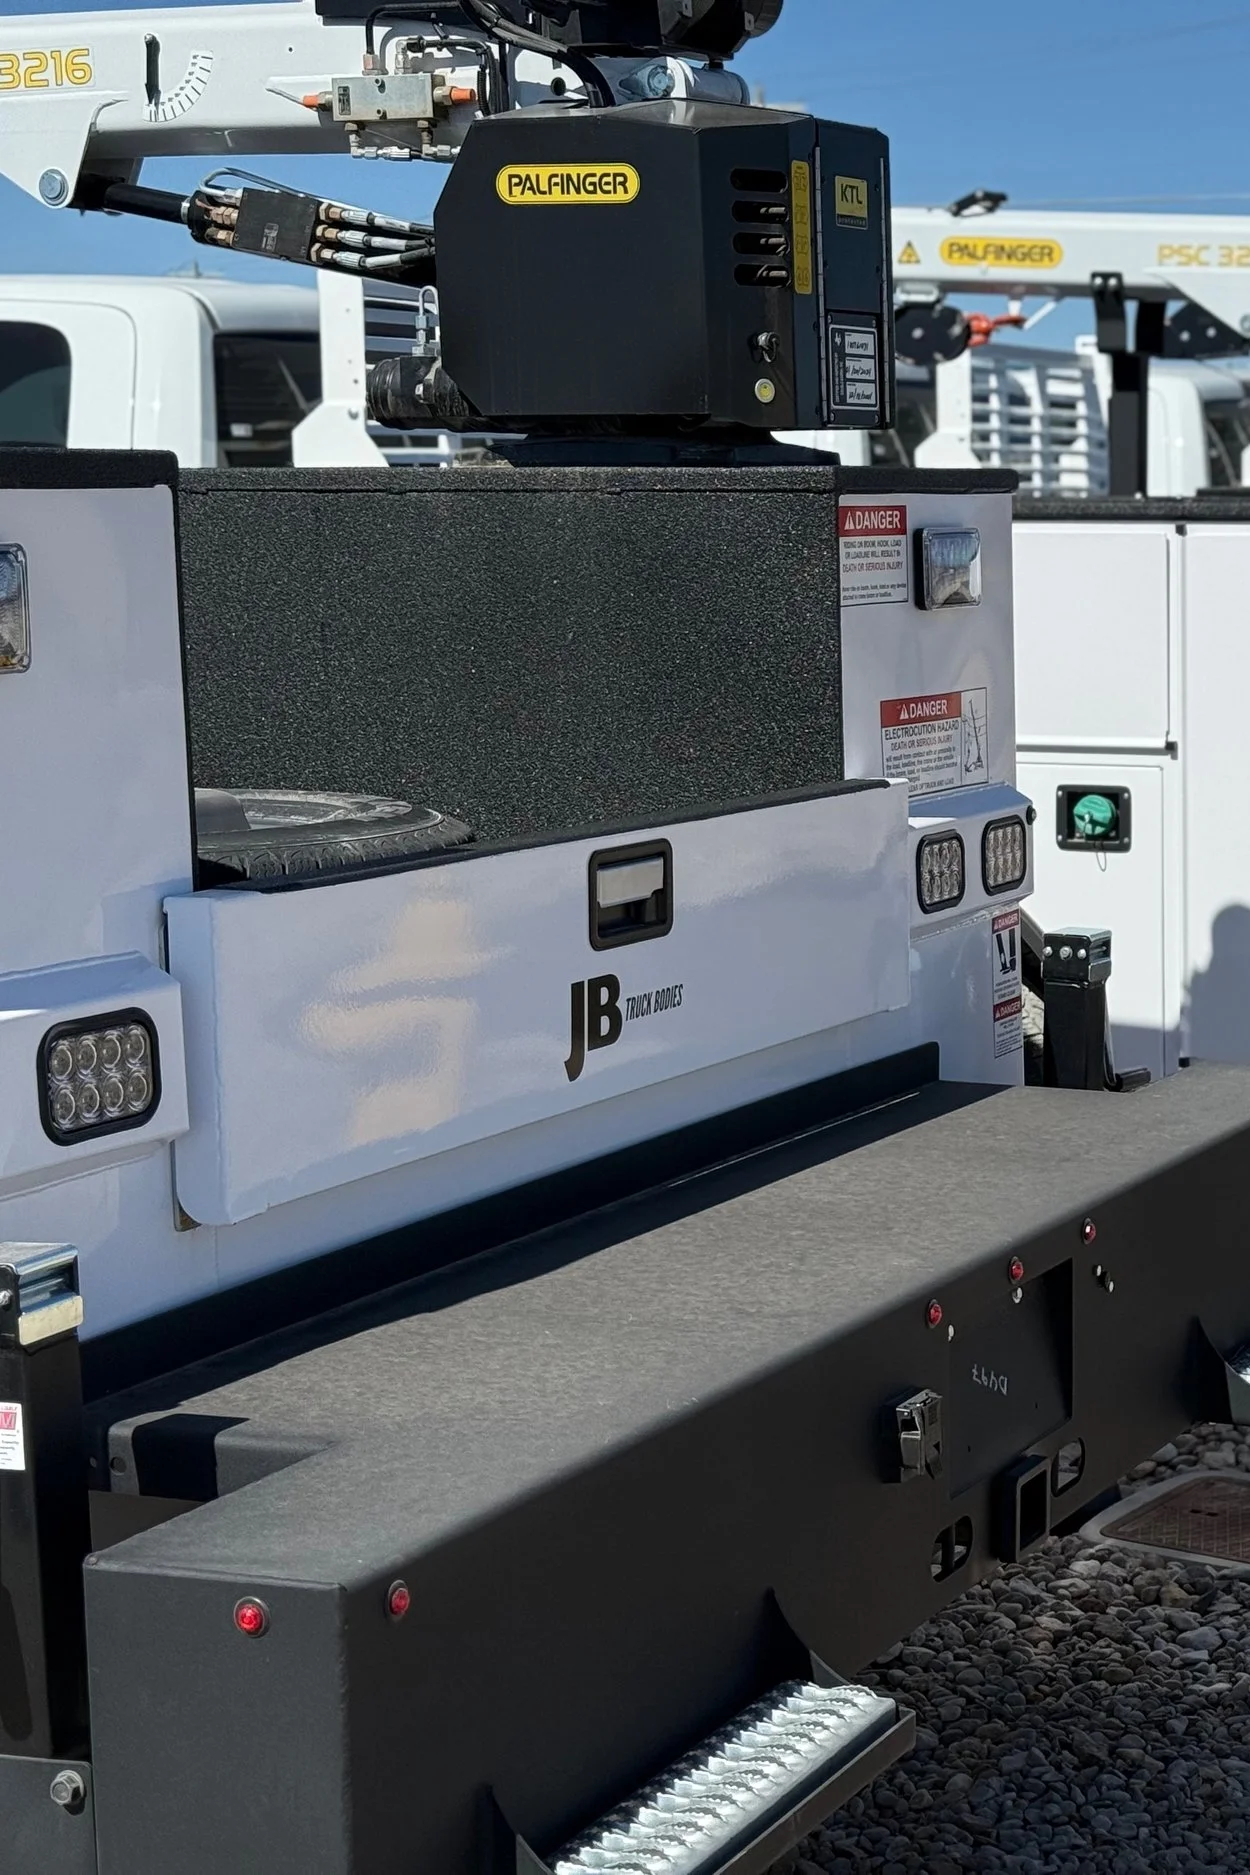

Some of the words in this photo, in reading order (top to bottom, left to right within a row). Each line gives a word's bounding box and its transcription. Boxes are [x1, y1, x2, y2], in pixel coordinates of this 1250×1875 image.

[0, 48, 92, 90] 3216
[507, 172, 629, 197] PALFINGER
[840, 183, 863, 205] KTL
[947, 242, 1055, 264] PALFINGER
[1157, 245, 1211, 267] PSC
[855, 510, 901, 530] DANGER
[909, 699, 948, 718] DANGER
[884, 724, 936, 741] ELECTROCUTION
[937, 719, 960, 733] HAZARD
[564, 973, 623, 1082] JB
[625, 992, 653, 1022] TRUCK
[653, 983, 684, 1014] BODIES
